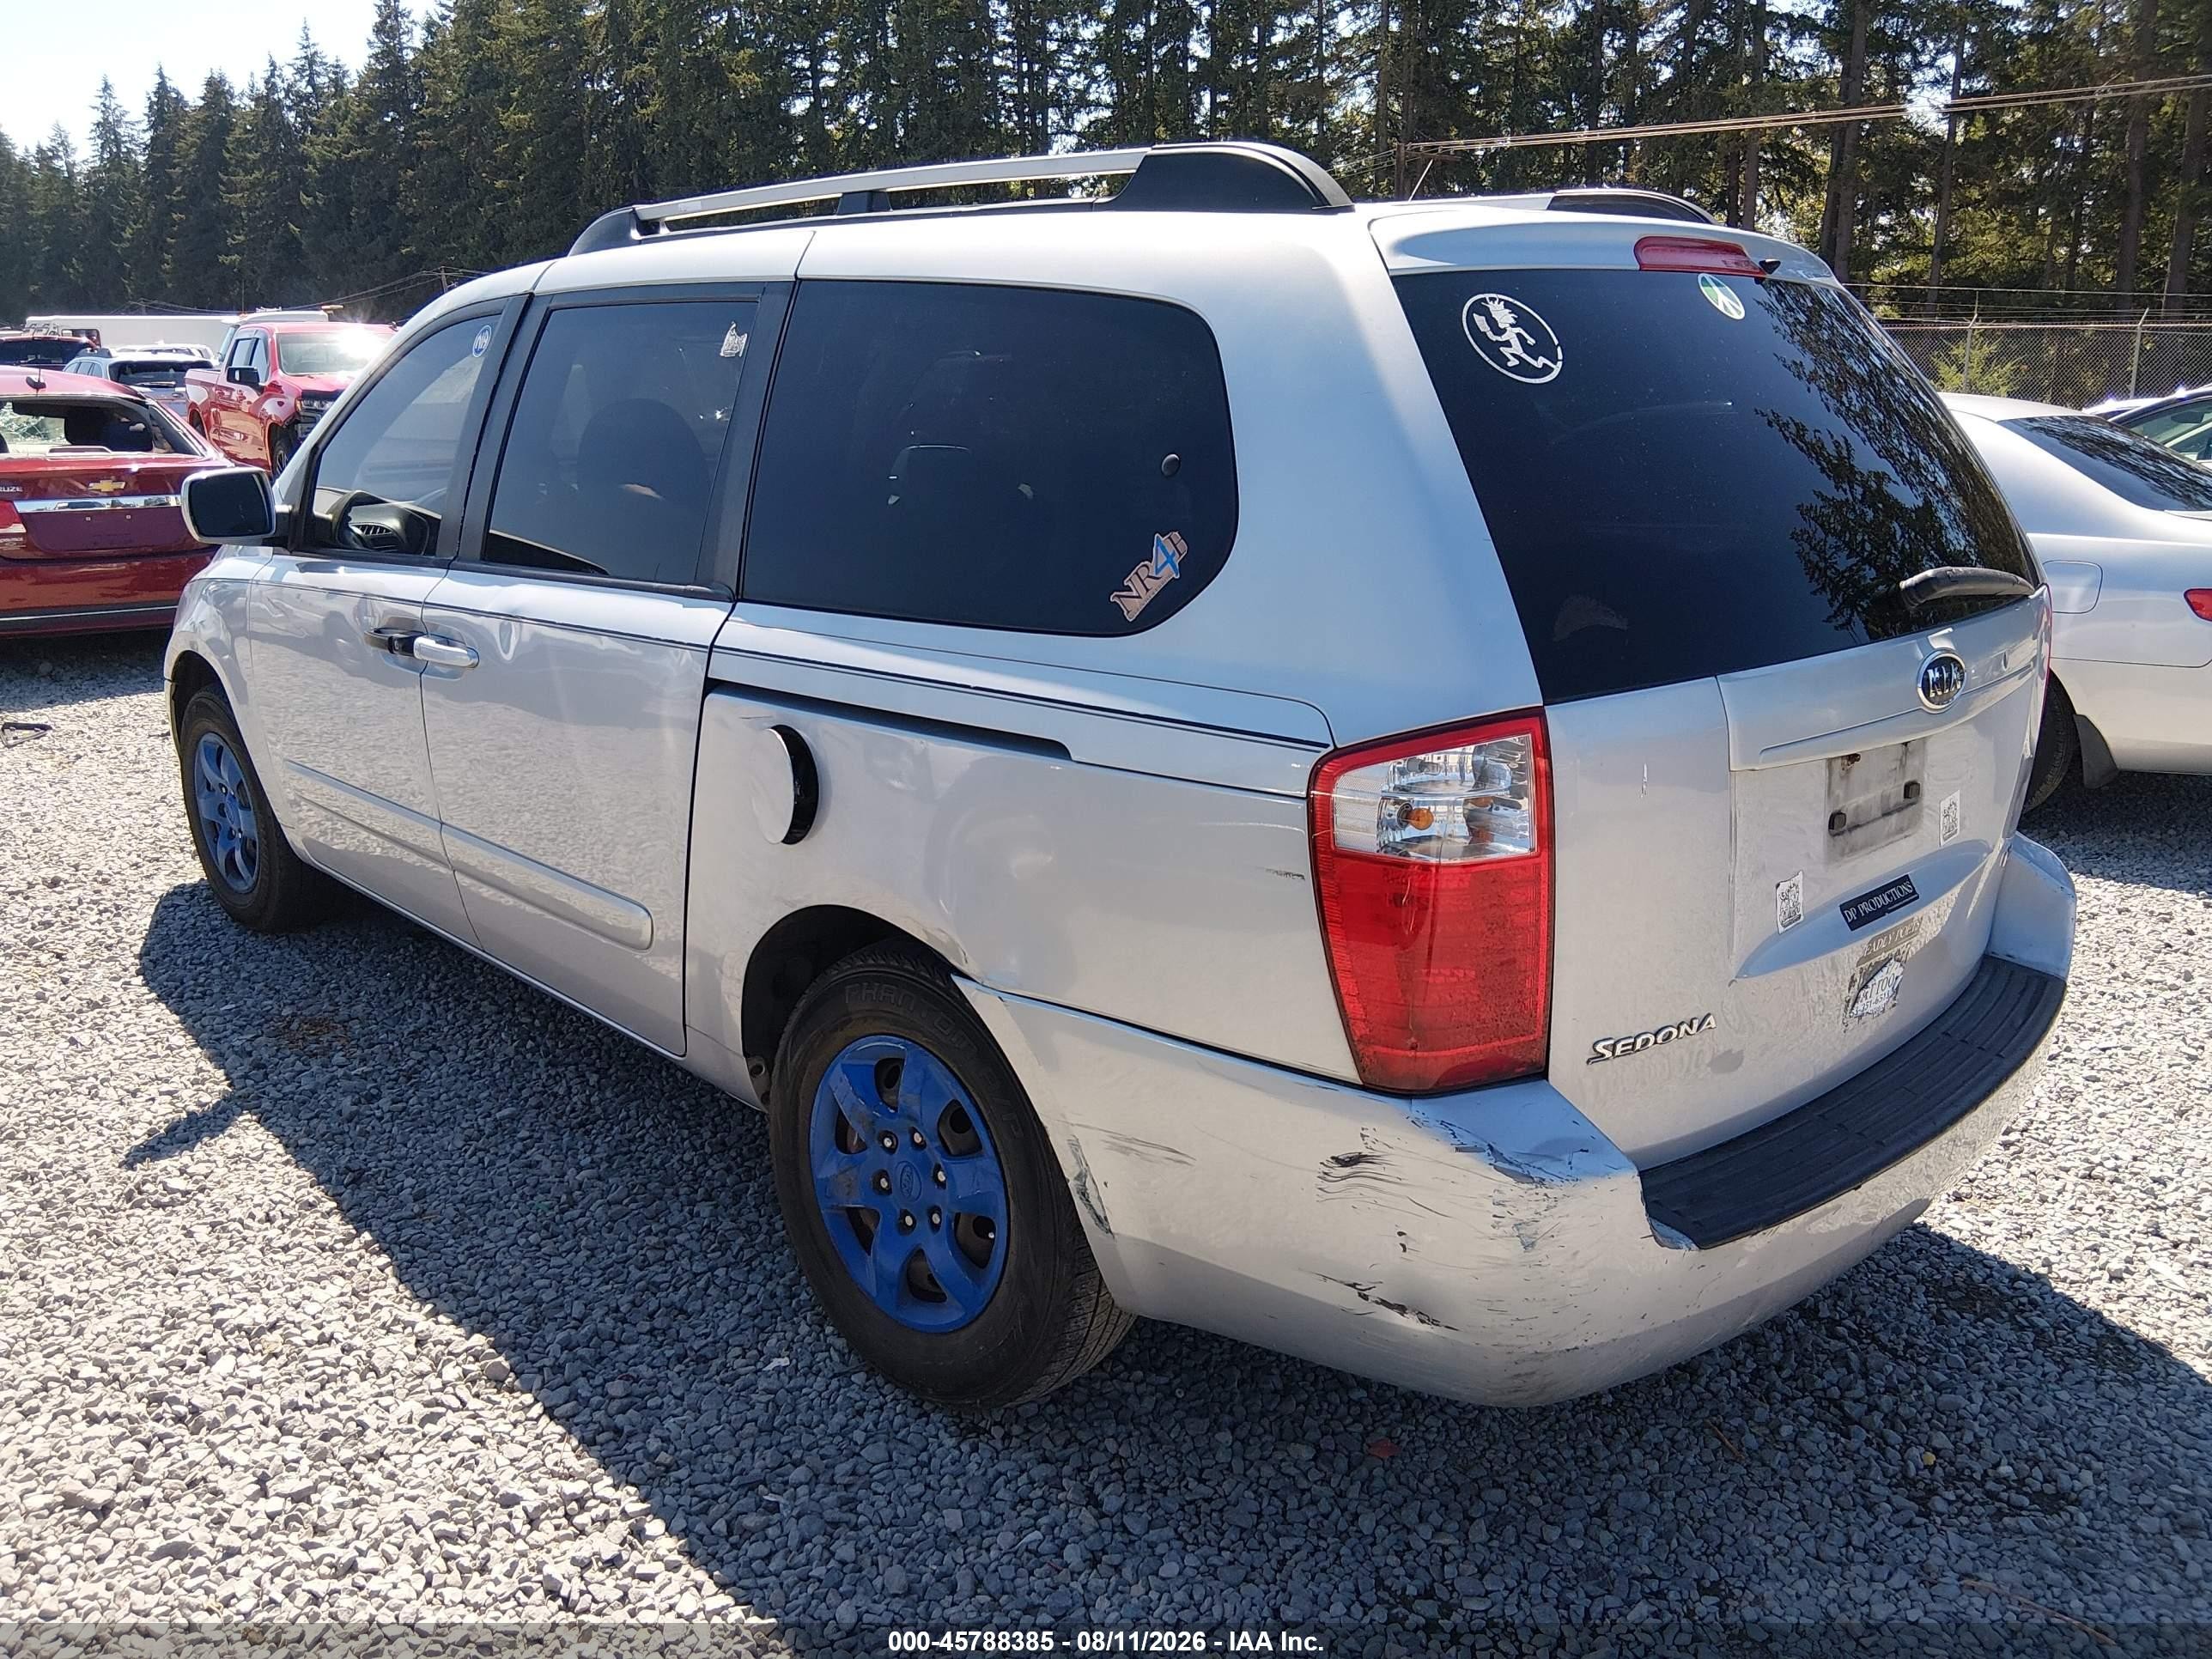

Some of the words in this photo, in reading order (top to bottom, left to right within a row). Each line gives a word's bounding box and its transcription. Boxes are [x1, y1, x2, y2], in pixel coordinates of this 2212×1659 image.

[1927, 662, 1961, 697] KIA
[1844, 908, 1857, 922] DP
[1857, 881, 1913, 916] PRODUCTIONS
[1587, 1012, 1717, 1065] SEDONA
